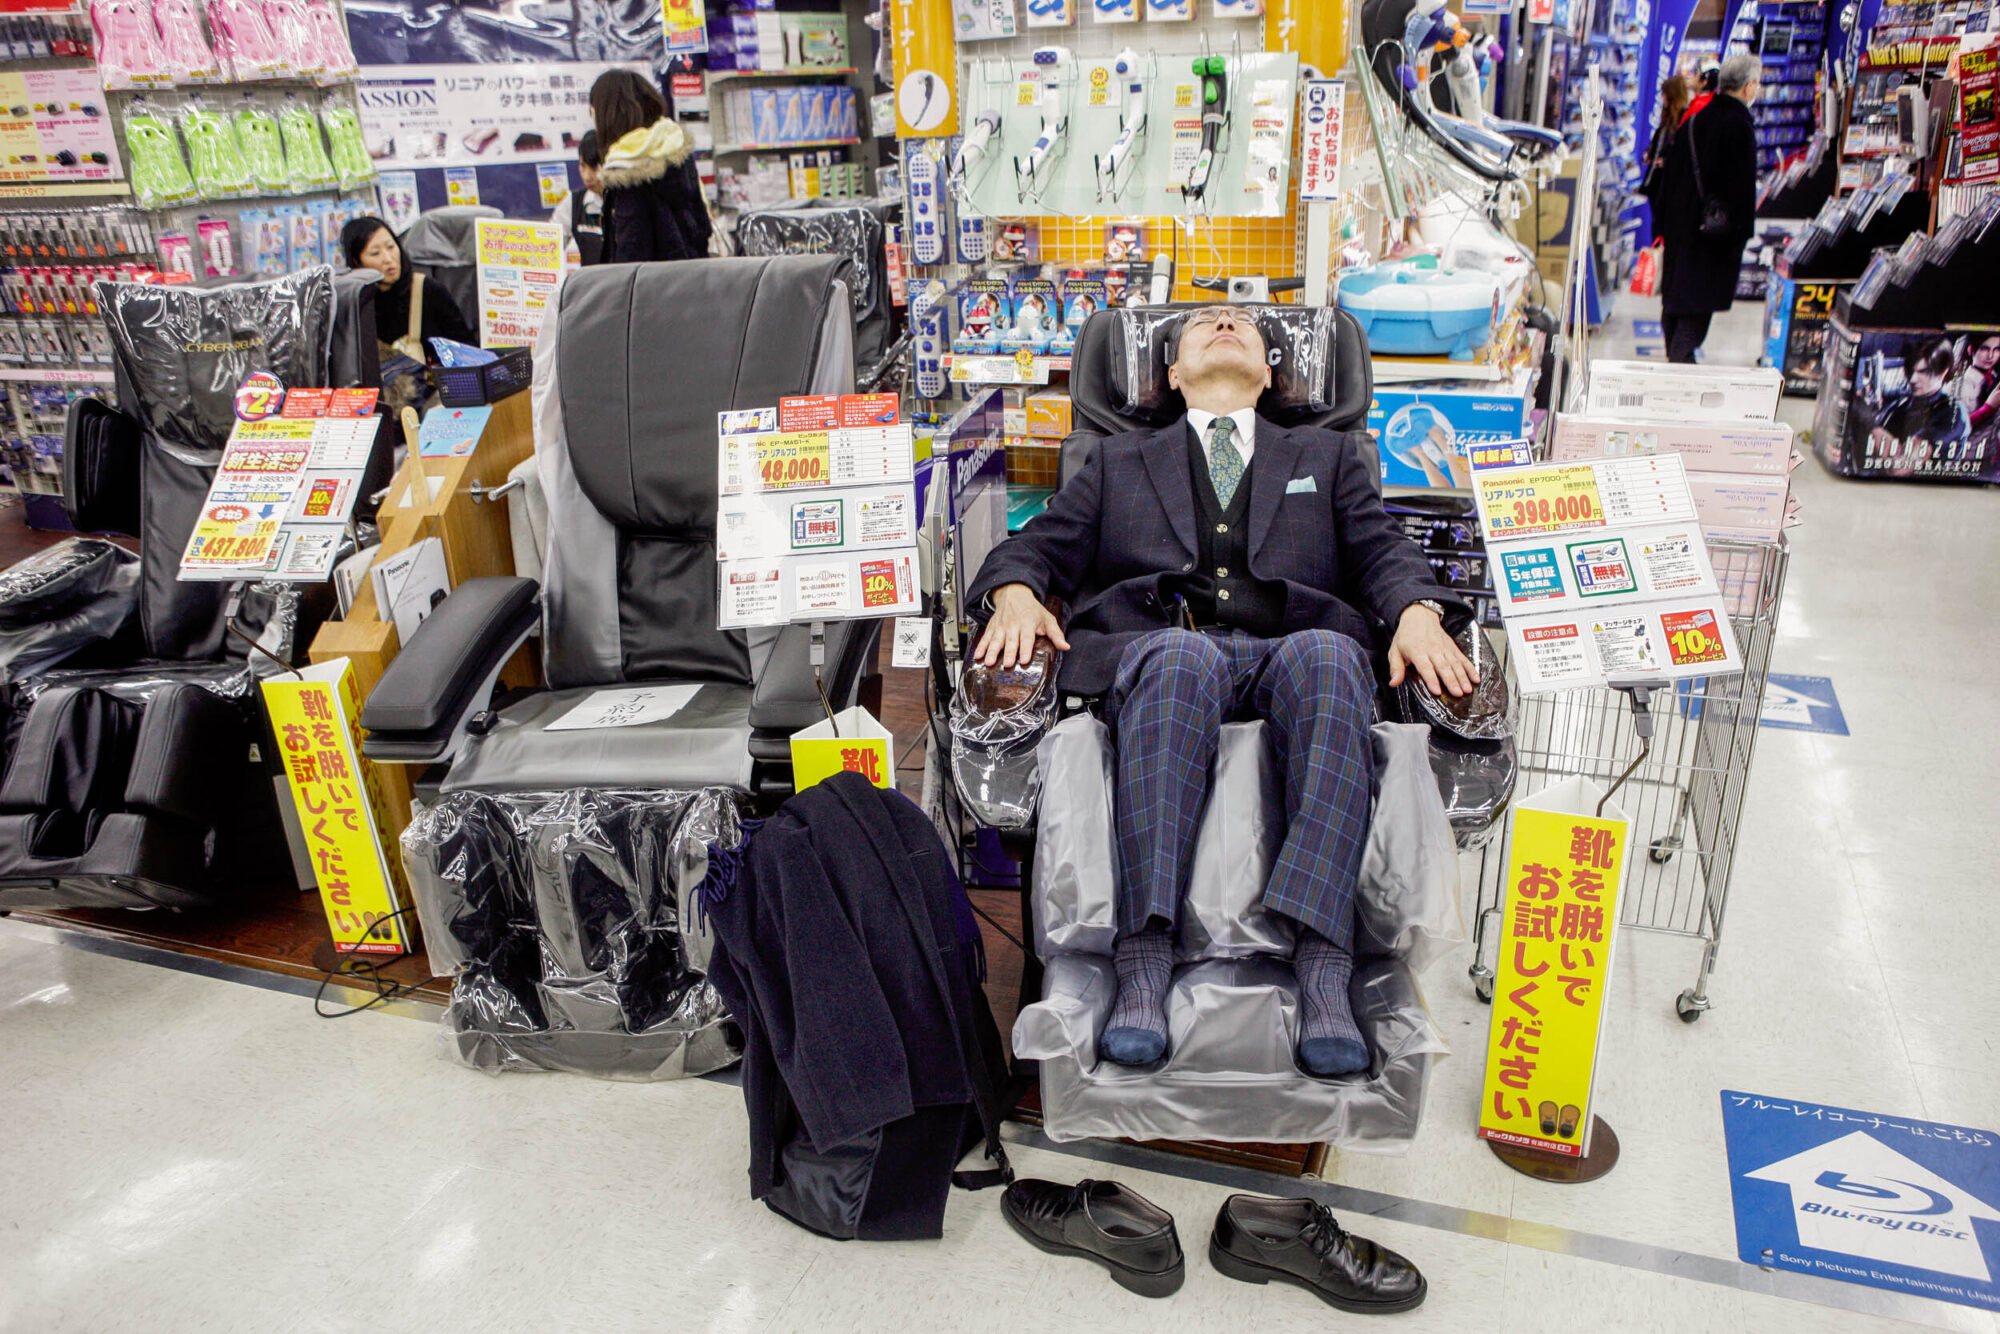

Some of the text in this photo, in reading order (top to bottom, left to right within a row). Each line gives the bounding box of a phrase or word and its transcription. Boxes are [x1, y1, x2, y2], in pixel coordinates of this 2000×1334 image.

[1897, 41, 1923, 64] TOHO
[1324, 107, 1340, 183] お持ち帰り
[1306, 132, 1322, 192] できます
[1796, 285, 1836, 312] 24
[246, 391, 270, 413] 2
[1865, 433, 1987, 458] biohazard
[957, 423, 1000, 492] Panasonic
[1863, 457, 1982, 473] DEGENERATION
[1482, 474, 1571, 488] Panasonic EP7000-K
[1558, 465, 1591, 474] ビックカメラ
[1485, 487, 1536, 501] リアルプロ
[807, 520, 836, 535] 無料
[1491, 516, 1514, 528] 税込
[1510, 565, 1556, 582] 5年保証
[1592, 562, 1625, 581] 無料
[865, 575, 894, 592] 10%
[1671, 628, 1722, 656] 10%
[1675, 651, 1726, 664] ポイントサービス
[298, 689, 360, 832] 靴を脱いで
[282, 723, 362, 934] お試しください
[1557, 825, 1616, 1007] 靴を脱いで
[1494, 863, 1562, 1121] お試しください
[1486, 1129, 1530, 1144] ビックカメラ
[1800, 1202, 1969, 1241] Blu-ray Disc
[1779, 1253, 1812, 1267] Sony
[1815, 1260, 1868, 1277] Pictures
[1870, 1270, 1964, 1296] Entertainment
